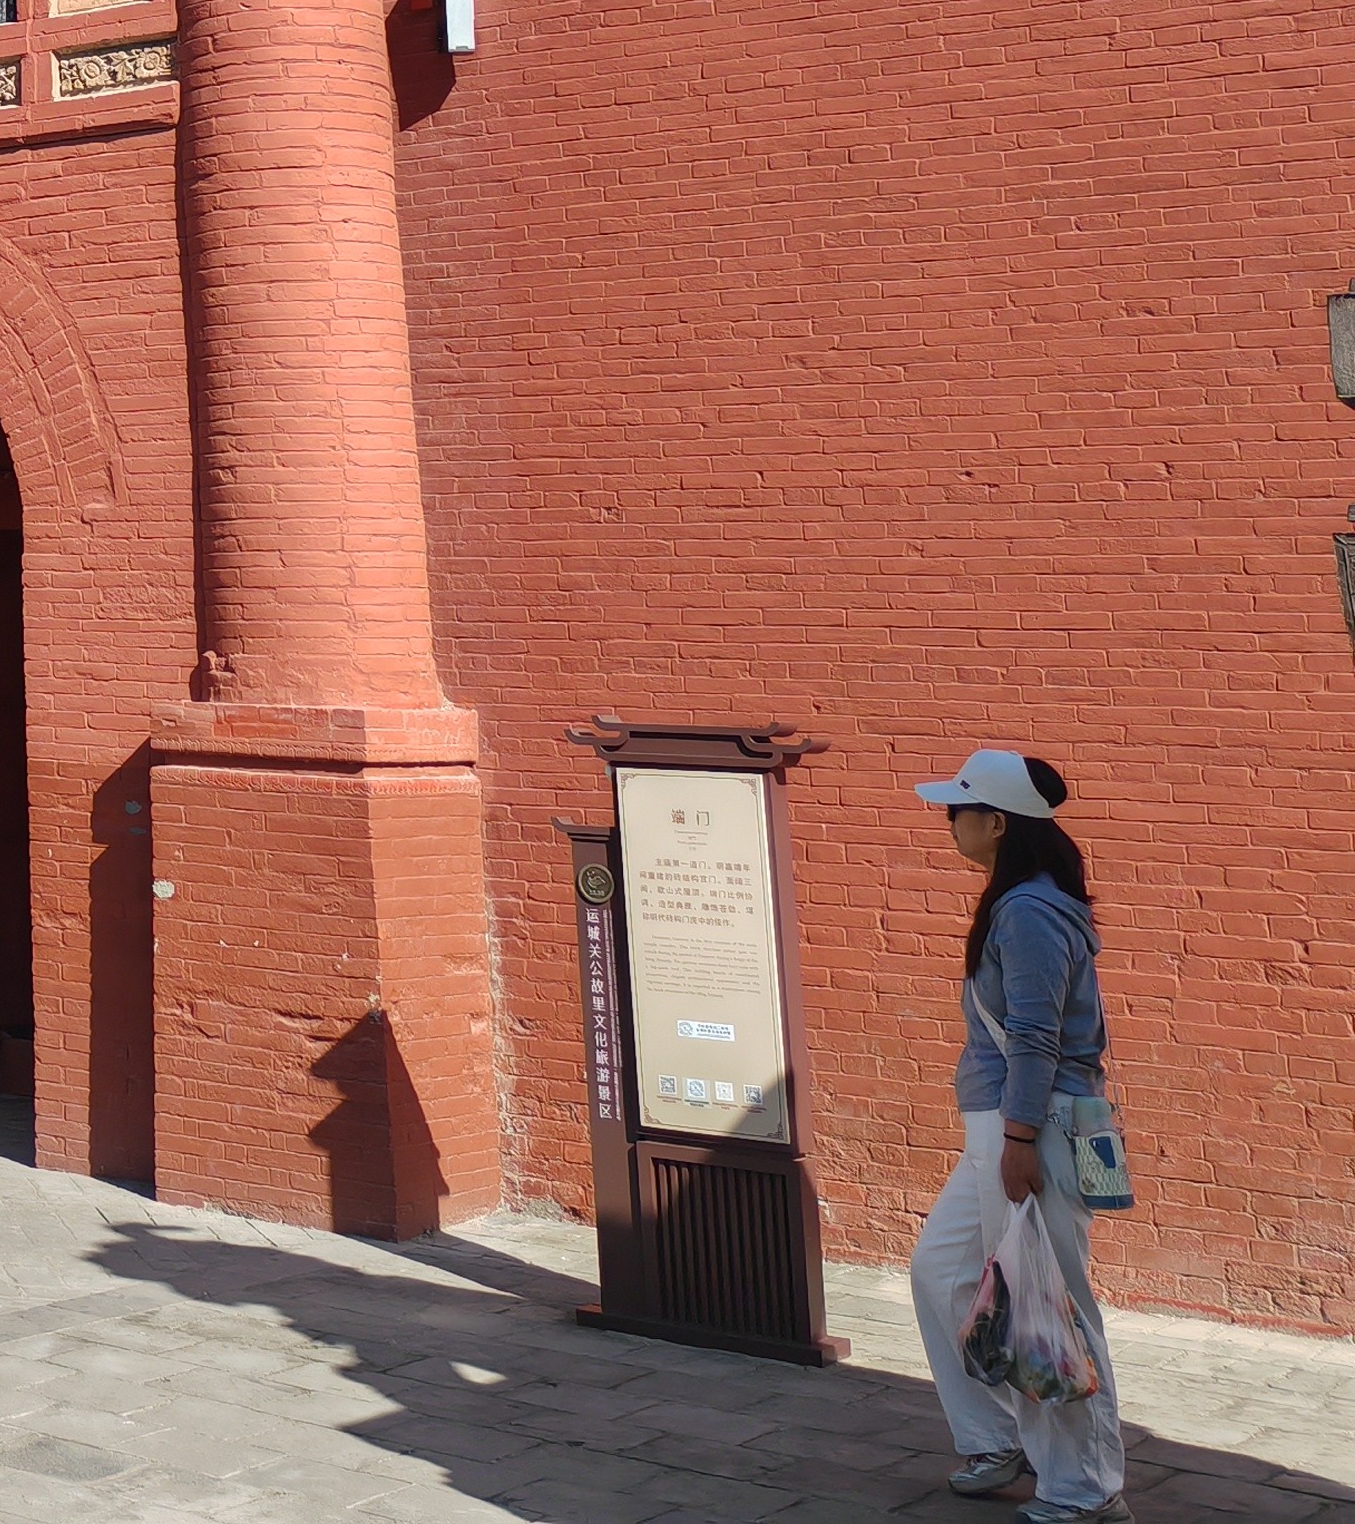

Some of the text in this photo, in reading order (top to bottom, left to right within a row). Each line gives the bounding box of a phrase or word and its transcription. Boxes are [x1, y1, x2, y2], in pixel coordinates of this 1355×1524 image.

[671, 808, 710, 827] 端门
[585, 907, 613, 1120] 运城关公故里文化旅游景区
